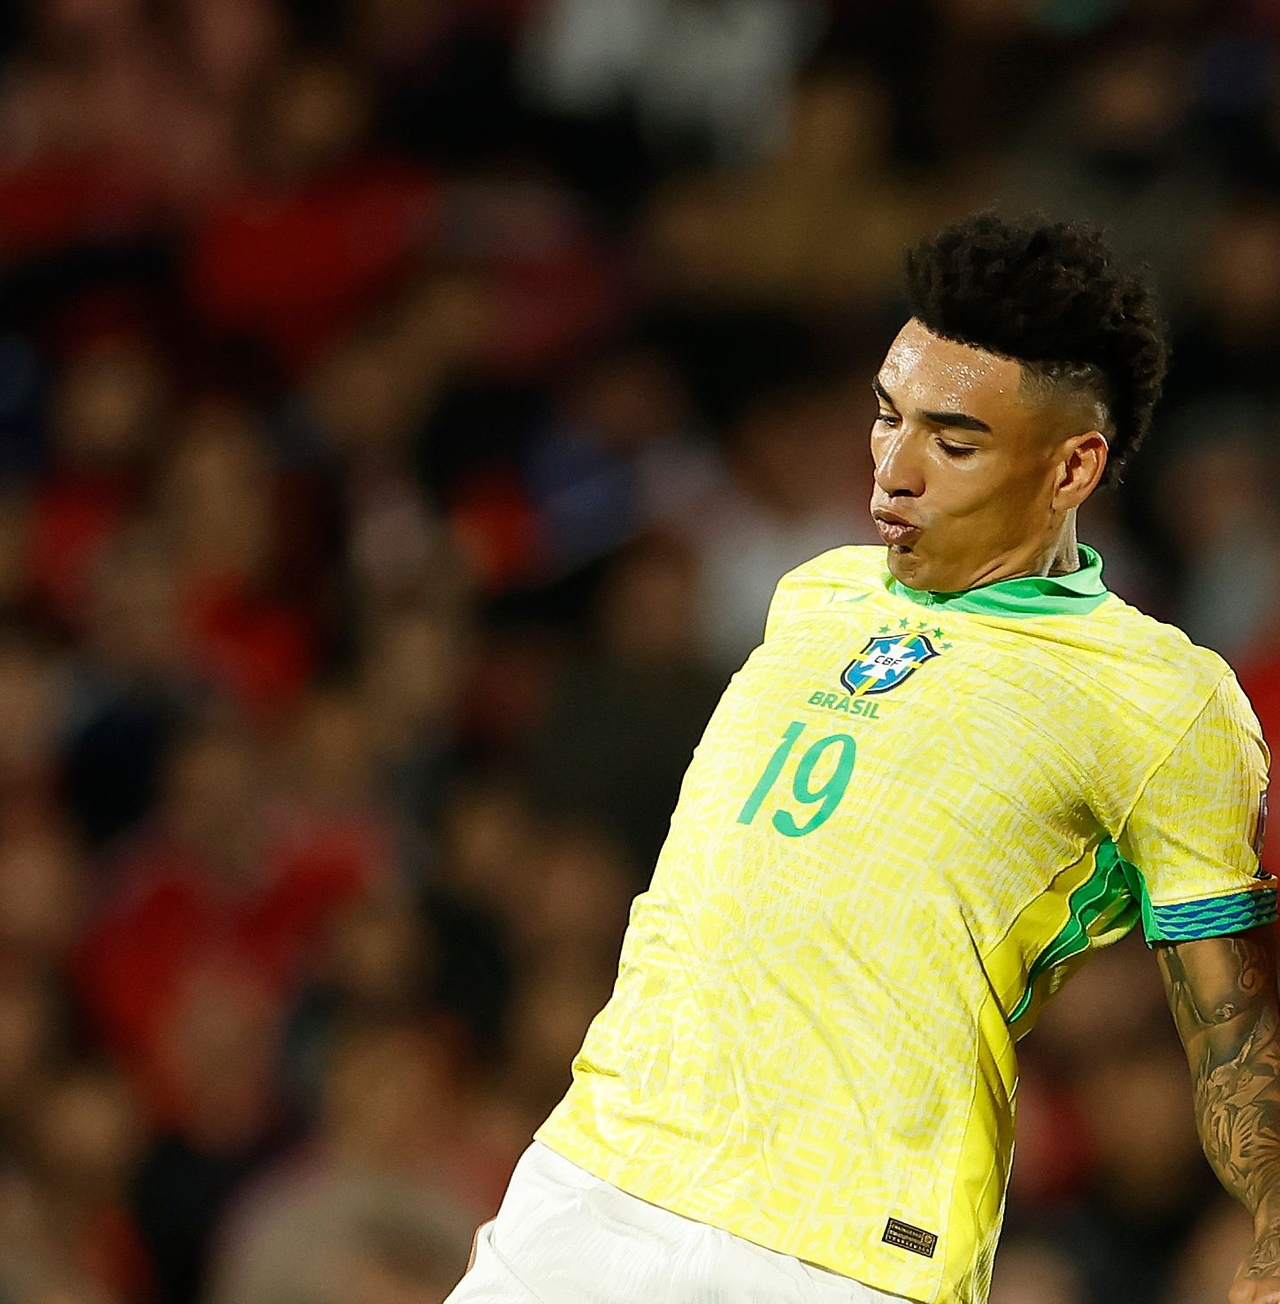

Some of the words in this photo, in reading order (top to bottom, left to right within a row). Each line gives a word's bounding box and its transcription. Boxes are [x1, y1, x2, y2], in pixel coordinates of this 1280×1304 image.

[874, 655, 902, 667] CBF
[807, 690, 880, 720] BRASIL
[736, 720, 857, 838] 19
